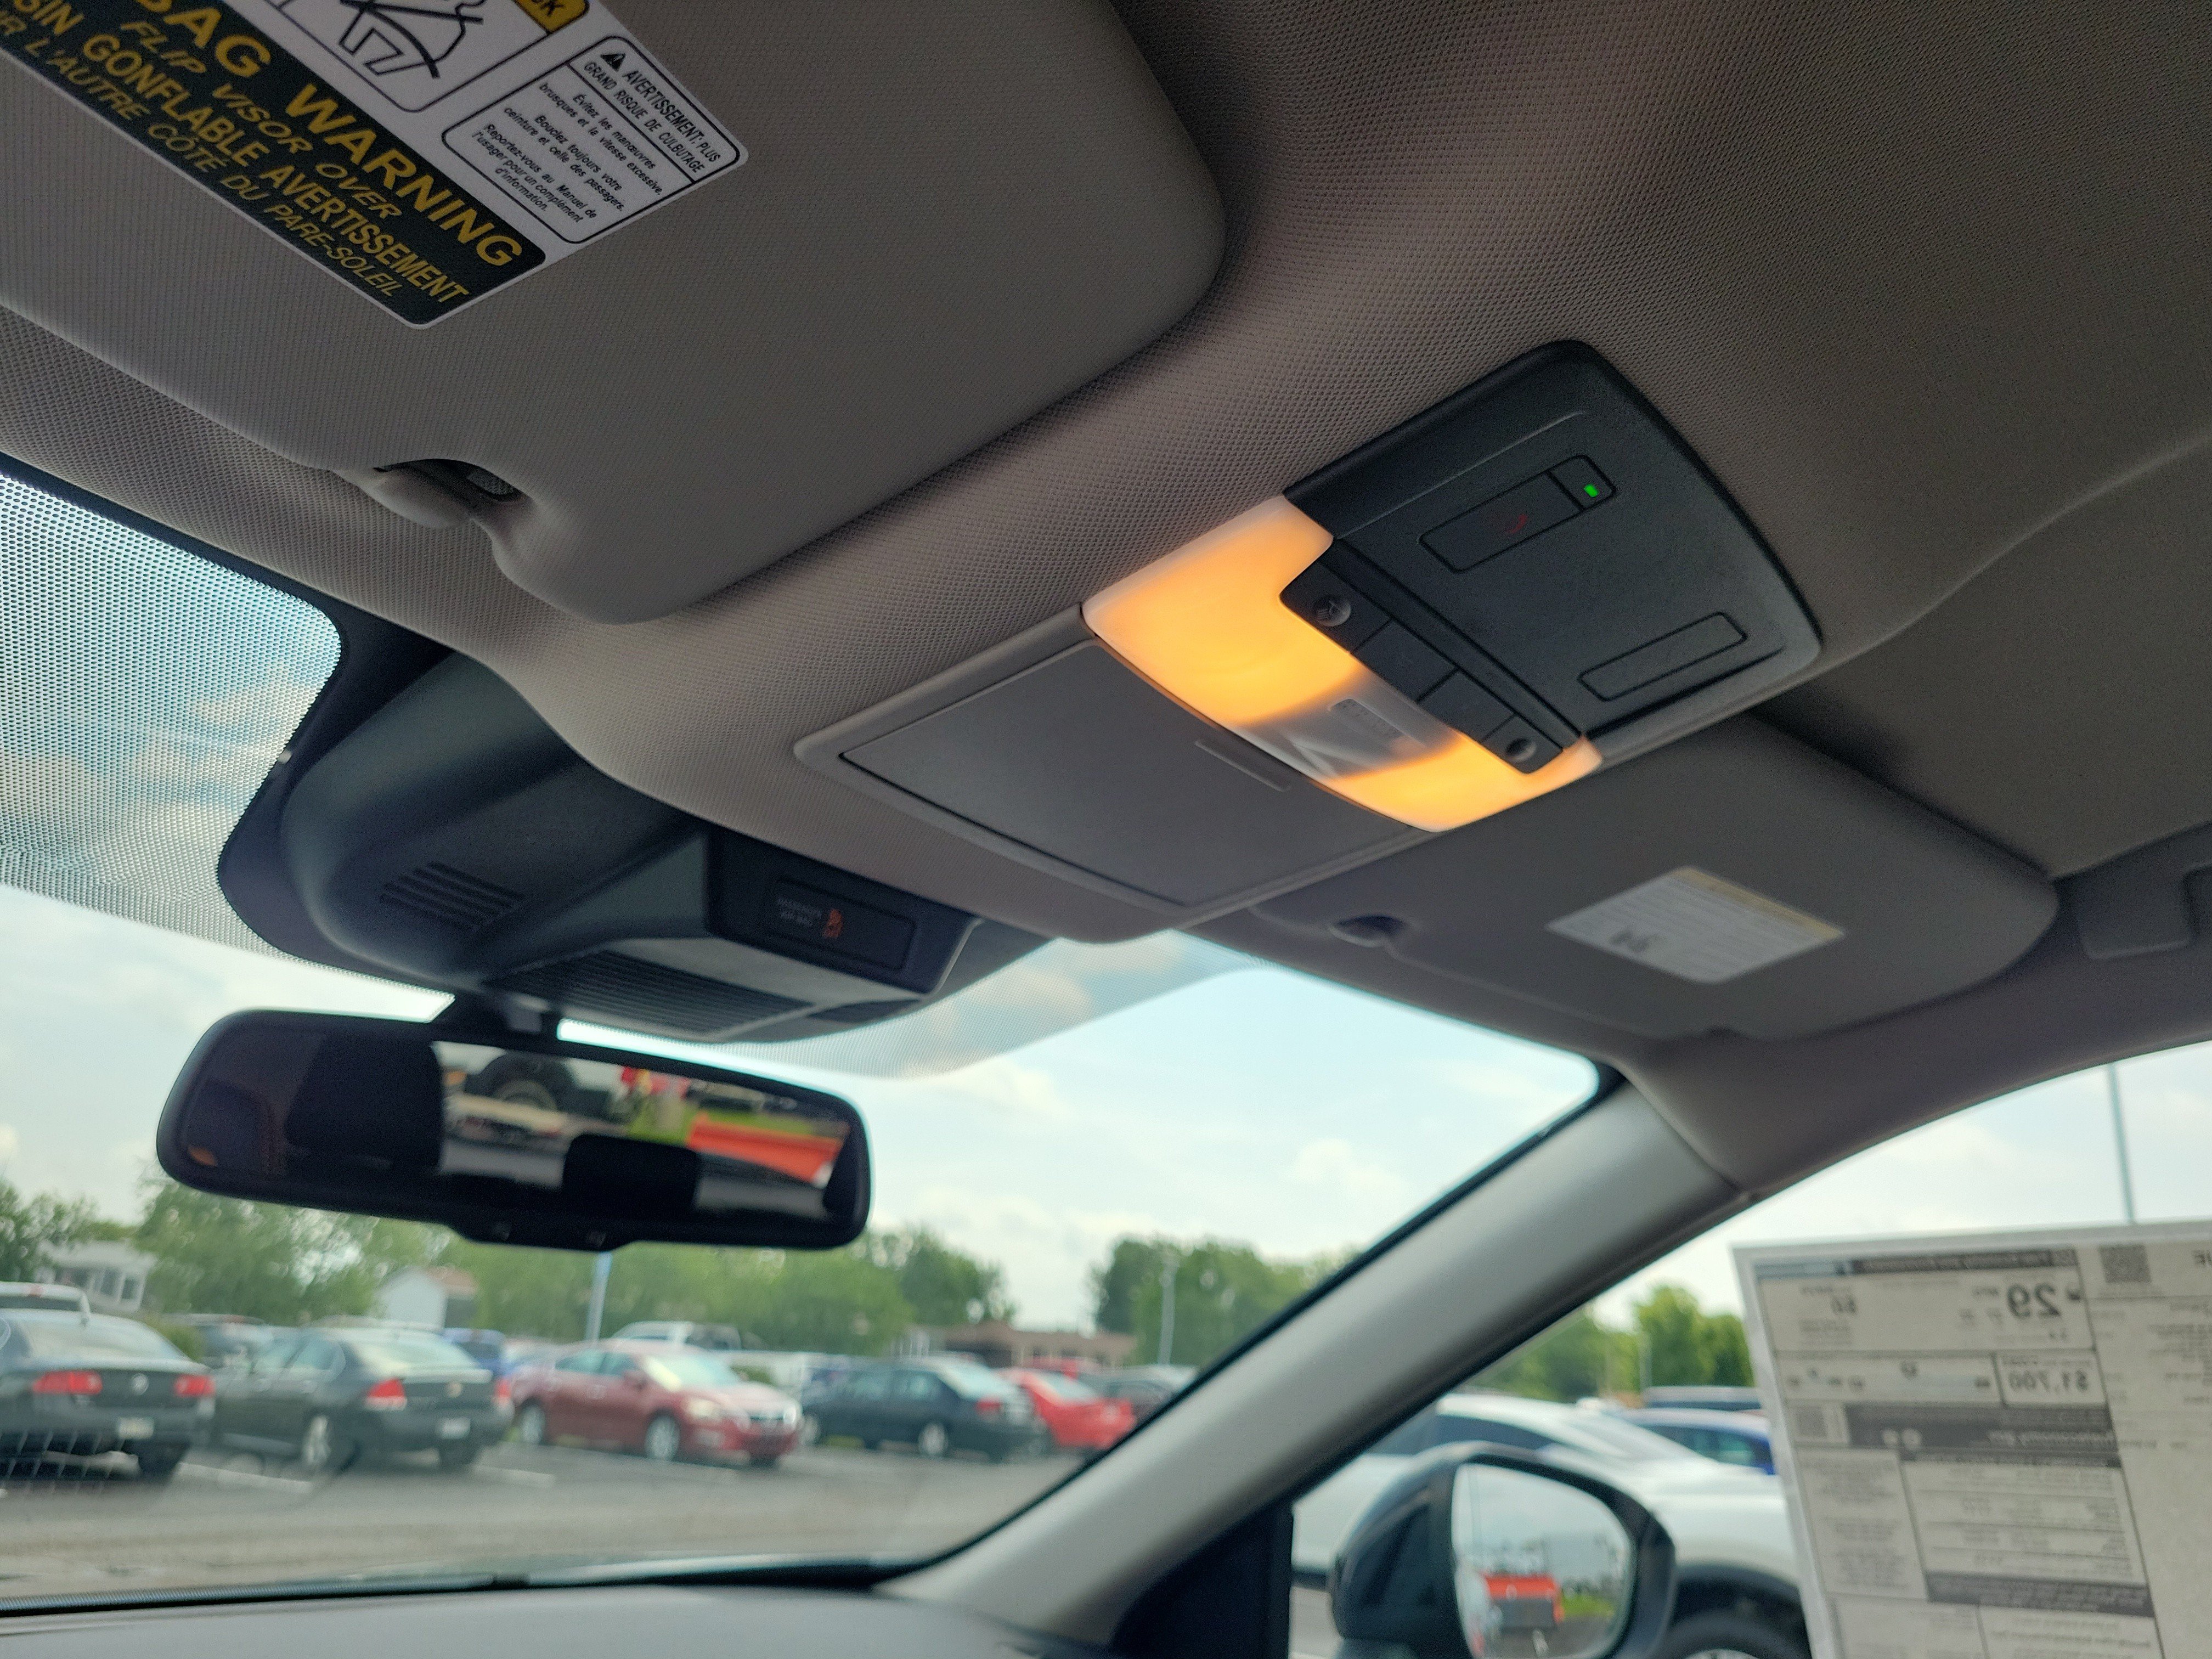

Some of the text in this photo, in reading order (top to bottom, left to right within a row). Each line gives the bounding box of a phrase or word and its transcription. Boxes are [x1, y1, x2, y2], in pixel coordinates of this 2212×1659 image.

[120, 21, 402, 218] FLIP VISOR OVER
[504, 107, 538, 137] ceinture
[538, 137, 551, 146] et
[549, 146, 570, 163] celle
[569, 164, 586, 177] des
[534, 114, 622, 191] Bouclez toujours votre
[539, 82, 578, 118] brusques
[578, 118, 589, 127] et
[588, 127, 599, 136] la
[599, 137, 627, 161] vitesse
[584, 61, 705, 173] GRAND RISQUE DE CULBUTAGE
[599, 117, 613, 131] les
[696, 142, 721, 162] PLUS
[25, 38, 151, 120] L'AUTRE
[221, 175, 269, 200] DU
[263, 204, 402, 297] PARE-SOLEIL
[83, 33, 270, 167] GONFLABLE
[259, 165, 469, 302] AVERTISSEMENT
[286, 83, 522, 266] WARNING
[472, 129, 583, 222] l'usager pour un complément
[484, 123, 597, 219] Reportez-vous au Manuel de
